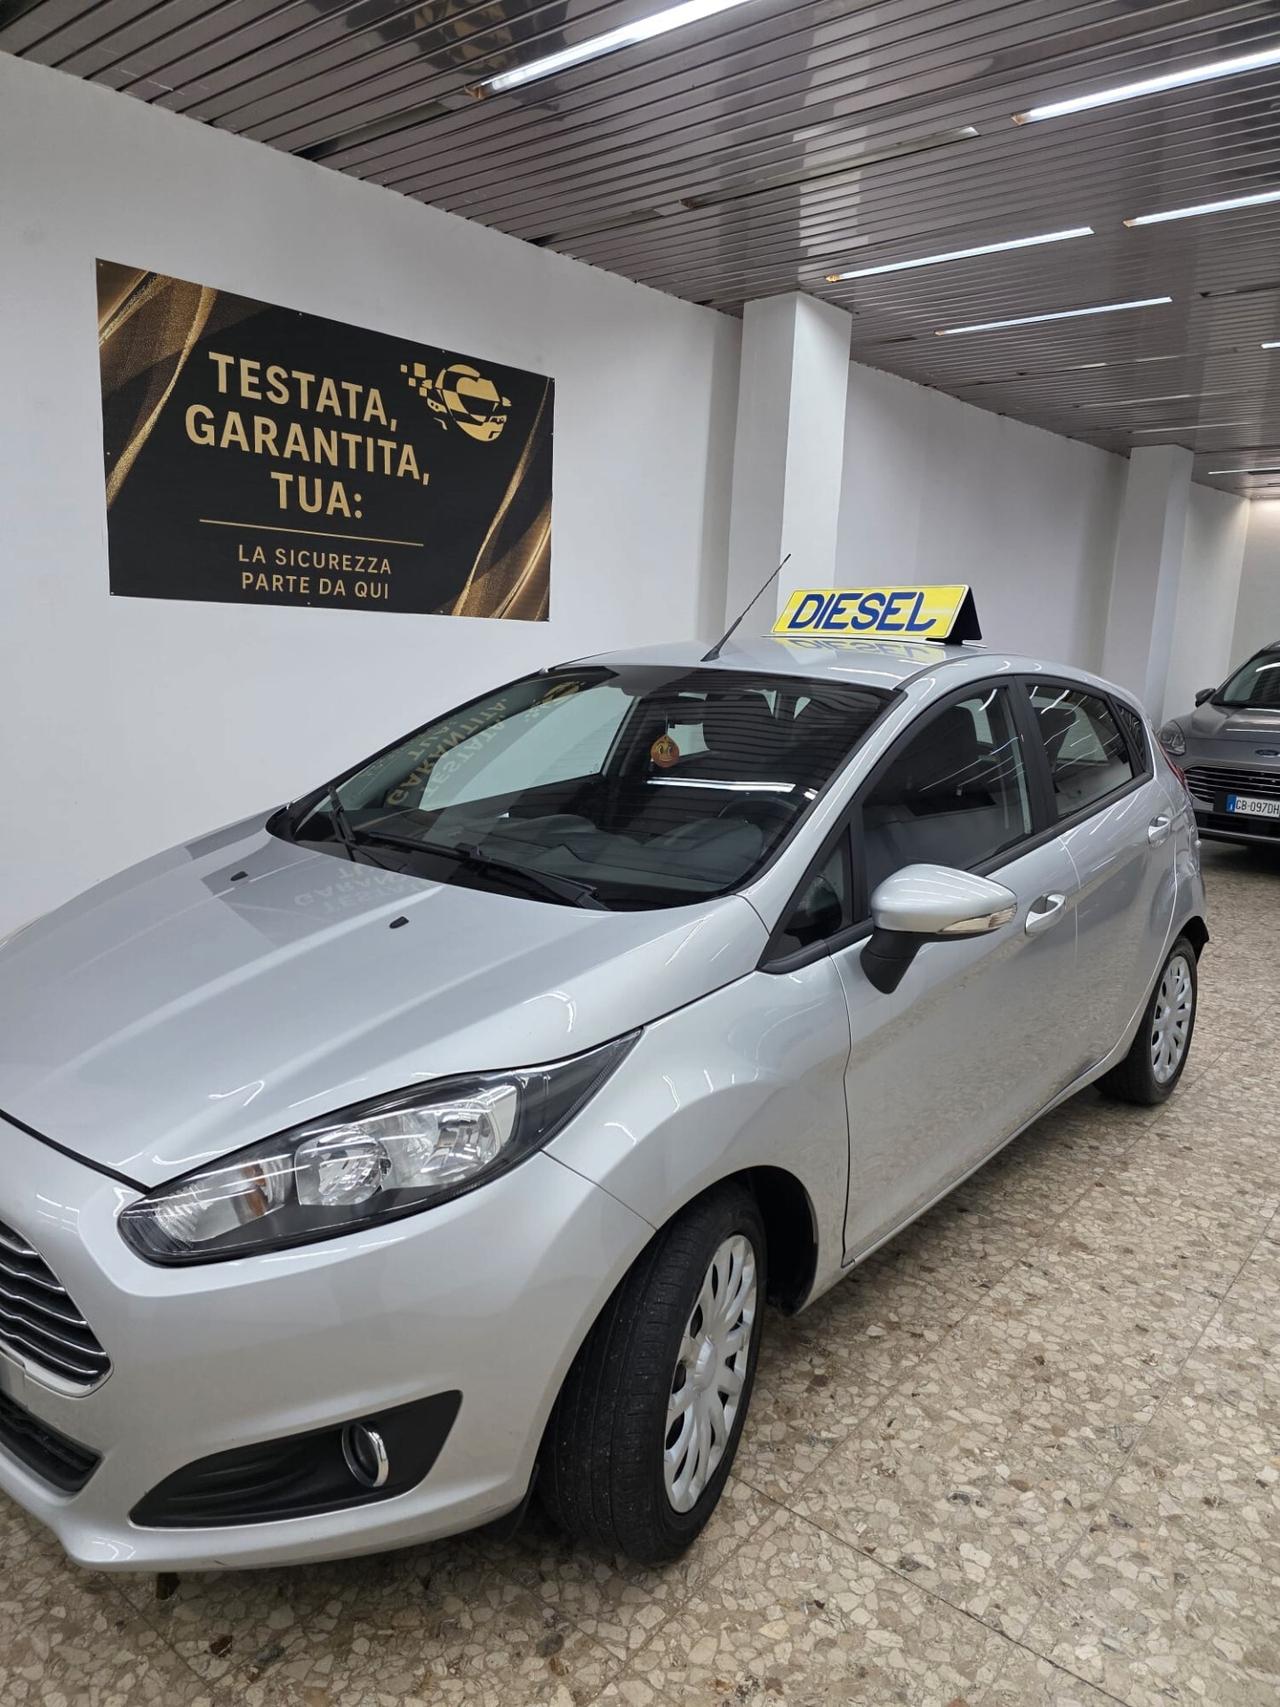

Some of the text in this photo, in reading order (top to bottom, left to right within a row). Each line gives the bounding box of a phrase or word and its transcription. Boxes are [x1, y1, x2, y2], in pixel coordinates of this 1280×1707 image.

[208, 351, 398, 432] TESTATA,
[184, 403, 430, 486] GARANTITA,
[270, 471, 362, 519] TUA:
[238, 543, 392, 575] LA SICUREZZA
[241, 571, 390, 601] PARTE DA QUI
[787, 591, 937, 632] DIESEL
